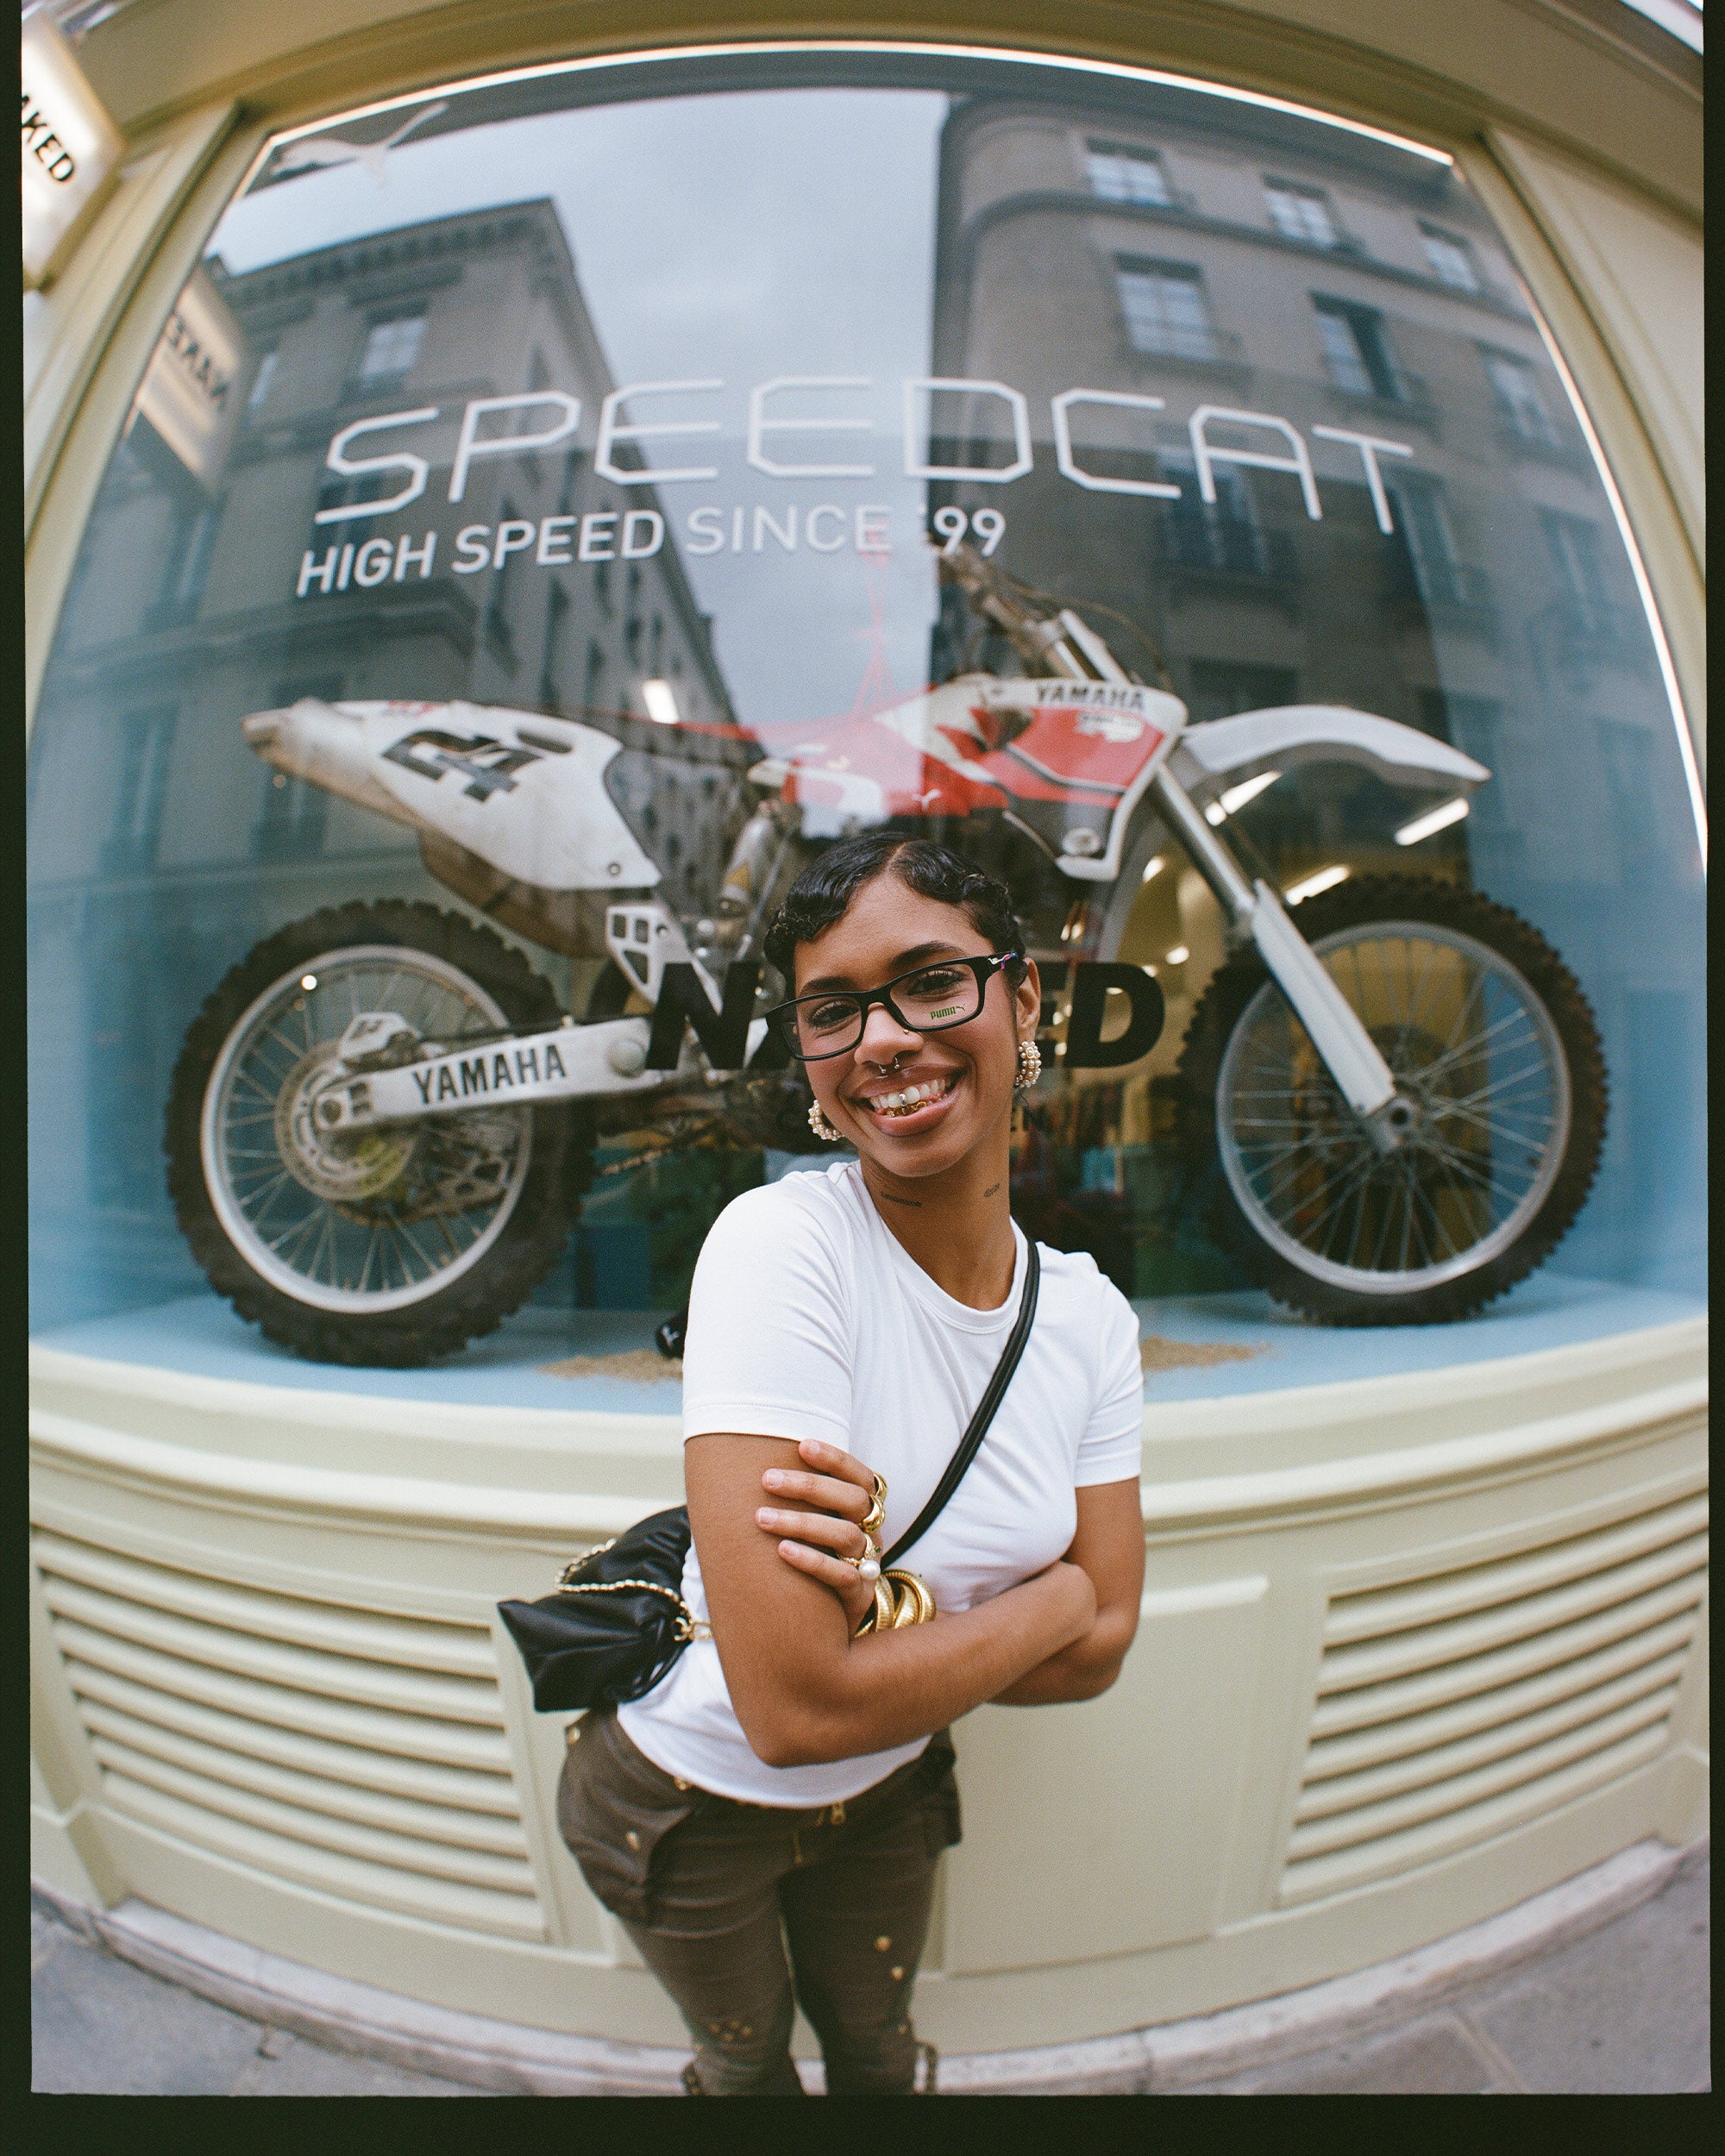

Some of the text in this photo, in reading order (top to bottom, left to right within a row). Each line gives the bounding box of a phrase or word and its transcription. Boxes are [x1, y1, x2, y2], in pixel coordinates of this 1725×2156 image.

[315, 377, 1413, 534] SPEEDCAT
[296, 531, 437, 597] HIGH
[451, 509, 664, 573] SPEED
[687, 504, 892, 555] SINCE
[1038, 685, 1144, 711] YAMAHA
[931, 1006, 956, 1019] PUMA
[413, 1044, 566, 1105] YAMAHA
